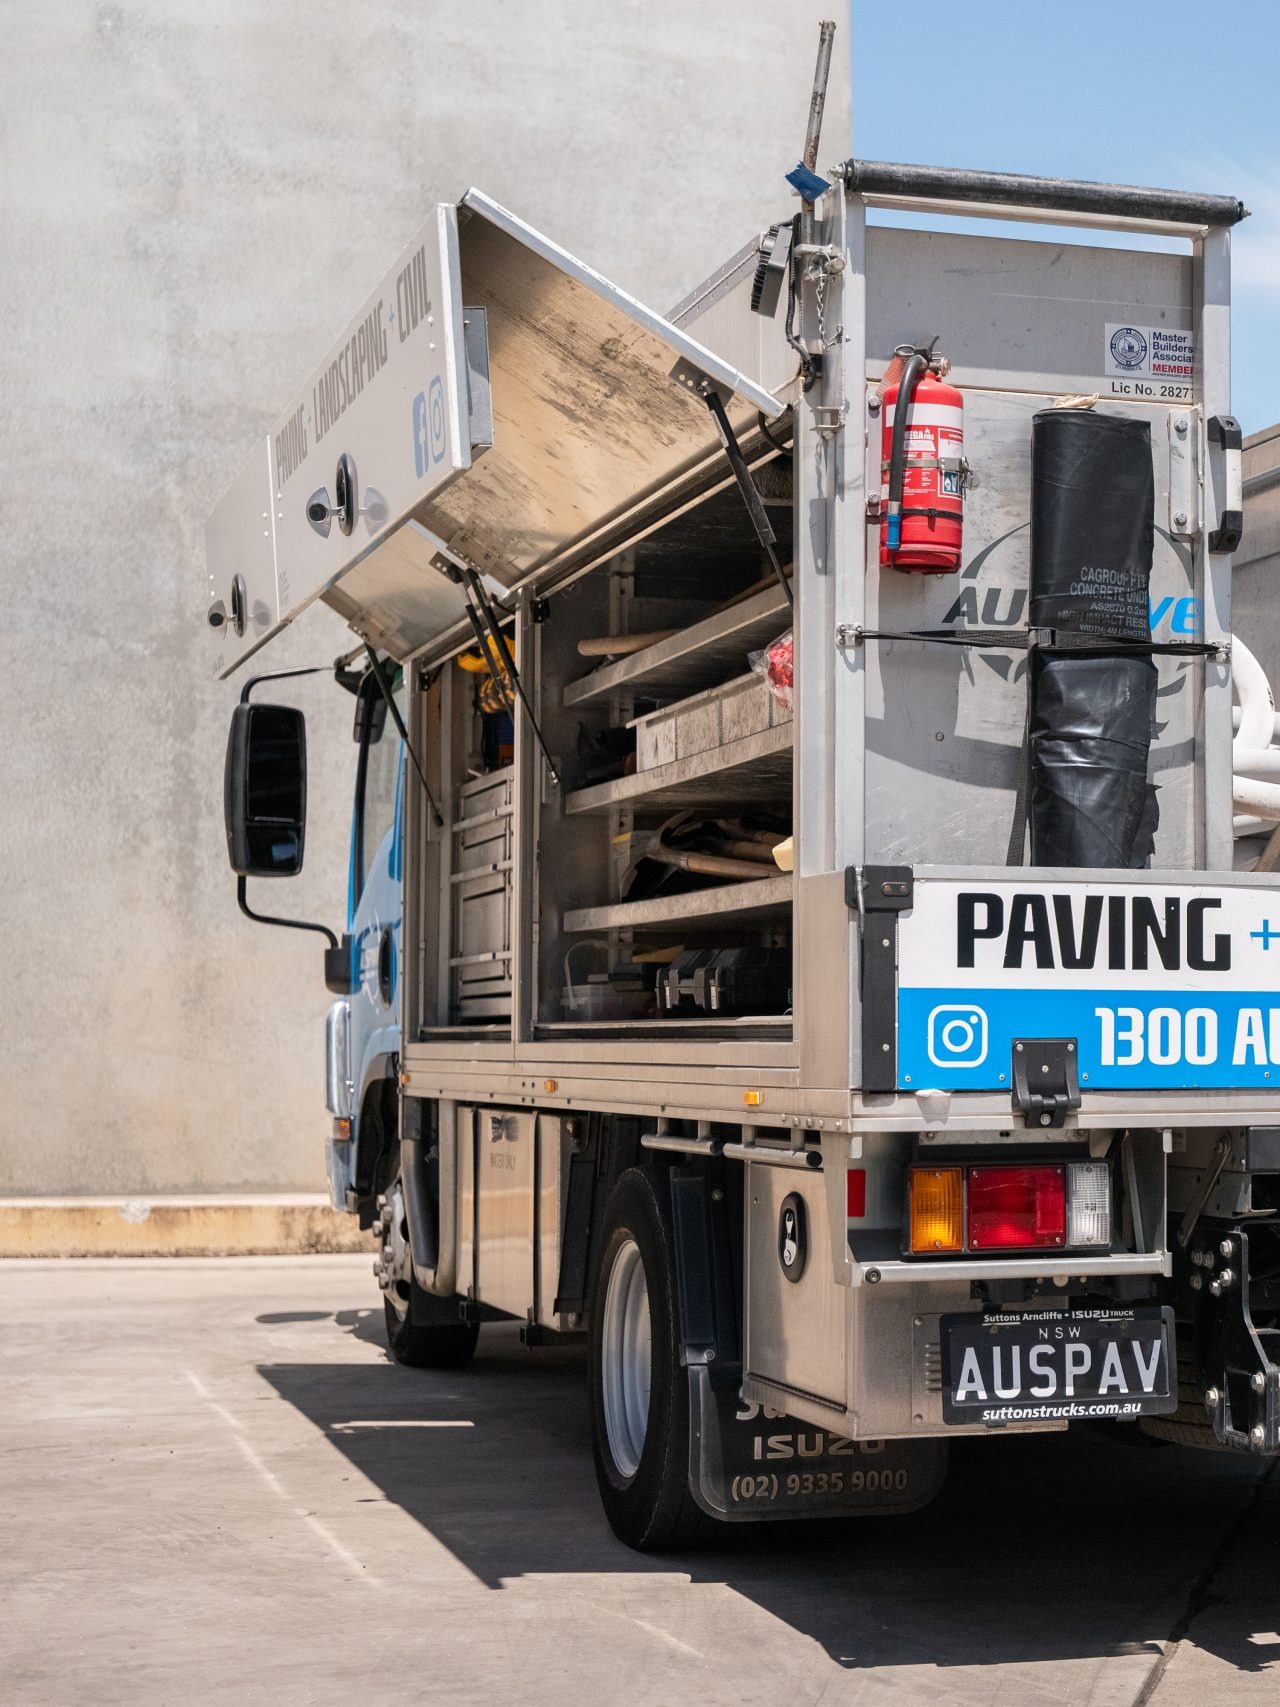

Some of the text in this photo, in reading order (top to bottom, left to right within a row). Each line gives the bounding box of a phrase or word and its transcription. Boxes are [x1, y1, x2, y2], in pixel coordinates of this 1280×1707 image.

[1152, 332, 1188, 343] Master
[1152, 342, 1194, 353] Builders
[275, 403, 308, 490] PAVING
[312, 298, 389, 444] LANDSCAPING
[396, 245, 432, 344] CIVIL
[1111, 381, 1131, 394] Lic
[1135, 384, 1156, 396] No.
[1080, 567, 1129, 586] CAGROUP
[1070, 582, 1126, 602] CONCRETE
[1057, 610, 1083, 622] HIGH
[1086, 612, 1123, 626] IMPACT
[956, 892, 1232, 972] PAVING
[1095, 1006, 1218, 1067] 1300
[984, 1310, 1134, 1323] Suttons Arncliffe ISUZU TRUCK
[955, 1338, 1162, 1401] AUSPAV
[982, 1402, 1142, 1421] suttonstrucks.com.au
[753, 1433, 886, 1460] ISUZU
[731, 1469, 909, 1502] (02) 9335 9000
